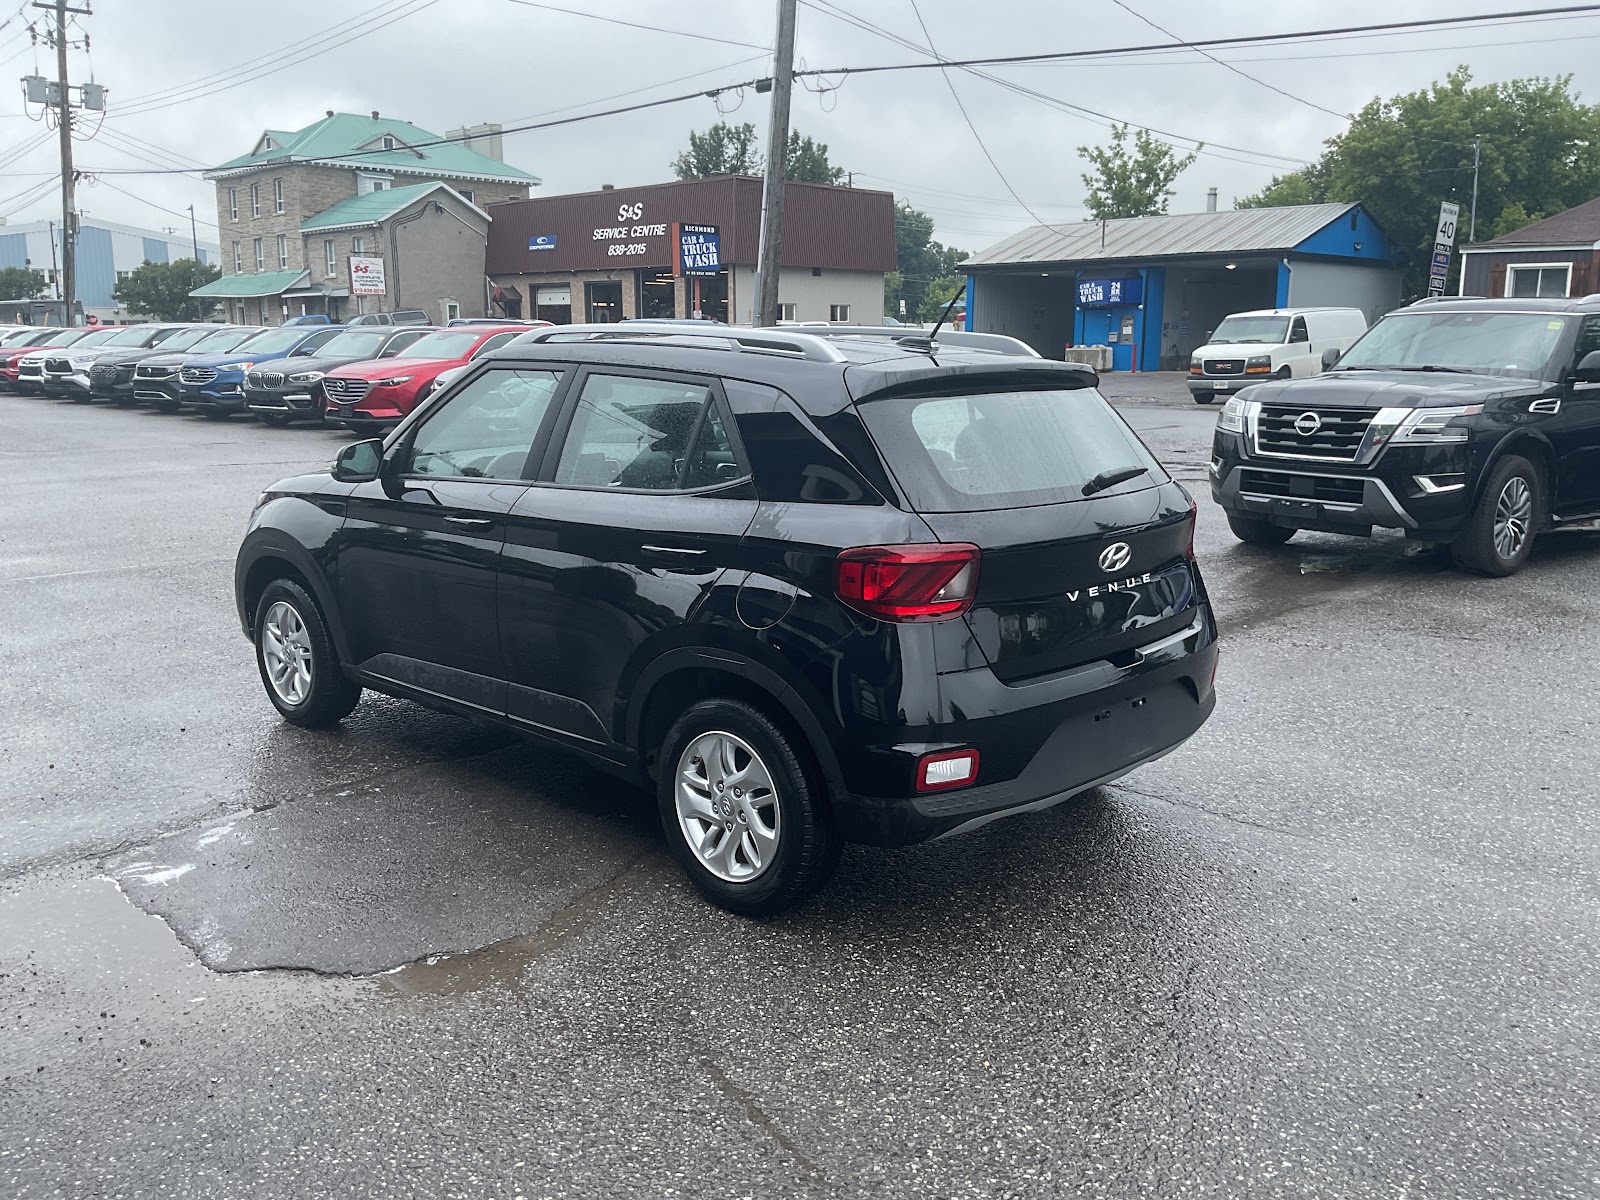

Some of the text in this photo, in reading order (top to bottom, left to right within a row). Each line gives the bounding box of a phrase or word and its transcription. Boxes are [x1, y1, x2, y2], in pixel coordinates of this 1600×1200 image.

[617, 202, 643, 222] S&S
[592, 223, 667, 241] SERVICE CENTRE
[684, 225, 715, 233] RICHMOND
[1439, 220, 1455, 239] 40
[681, 234, 705, 245] CAR &
[607, 243, 647, 256] 838-2015
[682, 242, 717, 256] TRUCK
[683, 252, 719, 268] WASH
[1080, 285, 1103, 296] TRUCK
[1080, 292, 1103, 303] WASH
[1066, 572, 1151, 602] VENUE
